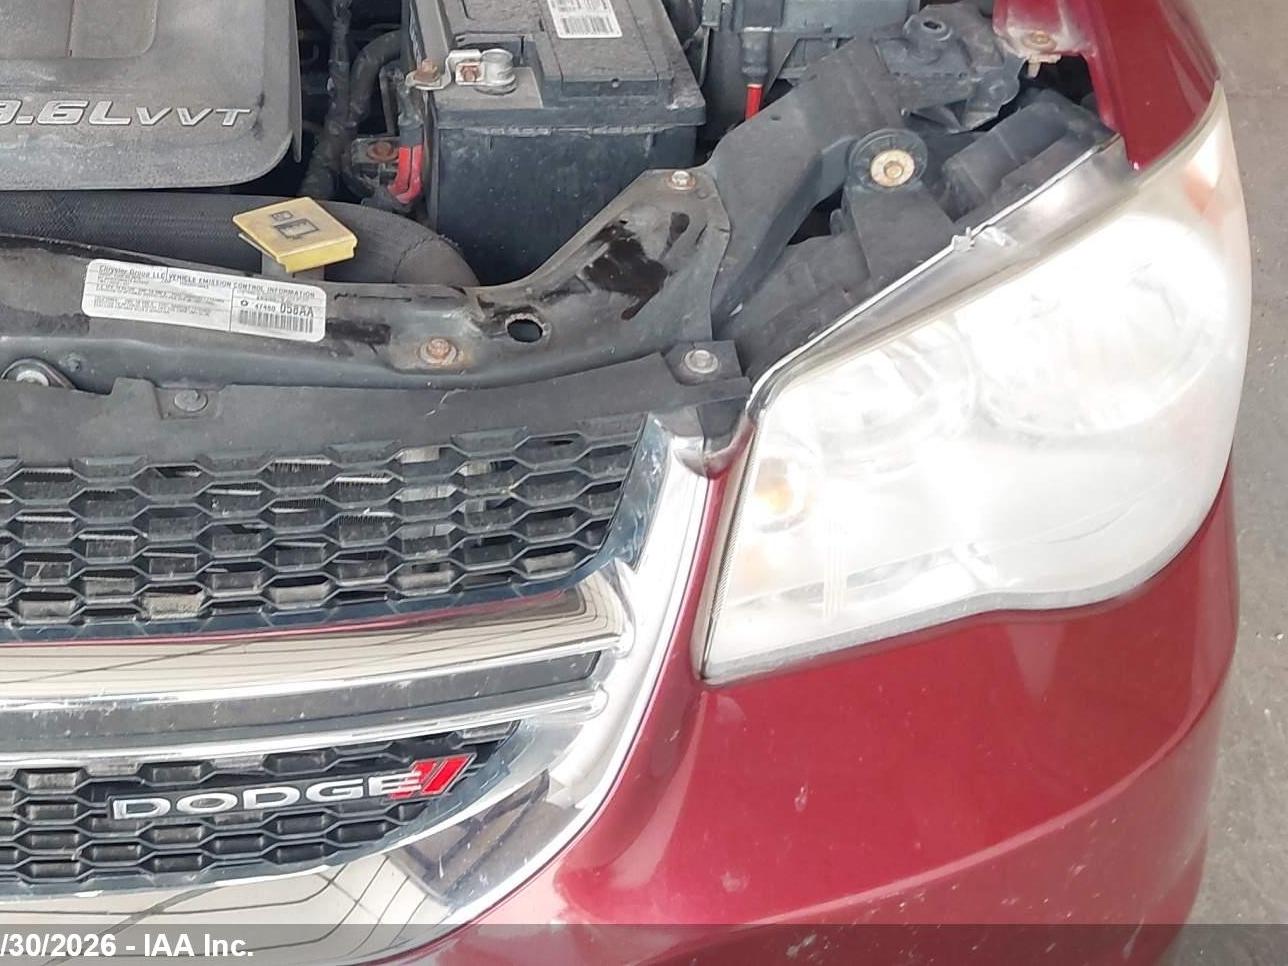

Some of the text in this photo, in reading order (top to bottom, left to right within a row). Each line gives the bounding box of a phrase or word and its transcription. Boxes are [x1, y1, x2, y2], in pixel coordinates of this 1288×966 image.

[168, 272, 197, 284] VEHICLE
[198, 277, 232, 288] EMISSION
[233, 281, 265, 292] CONTROL
[267, 286, 316, 298] INFORMATION
[113, 771, 420, 820] DODGE
